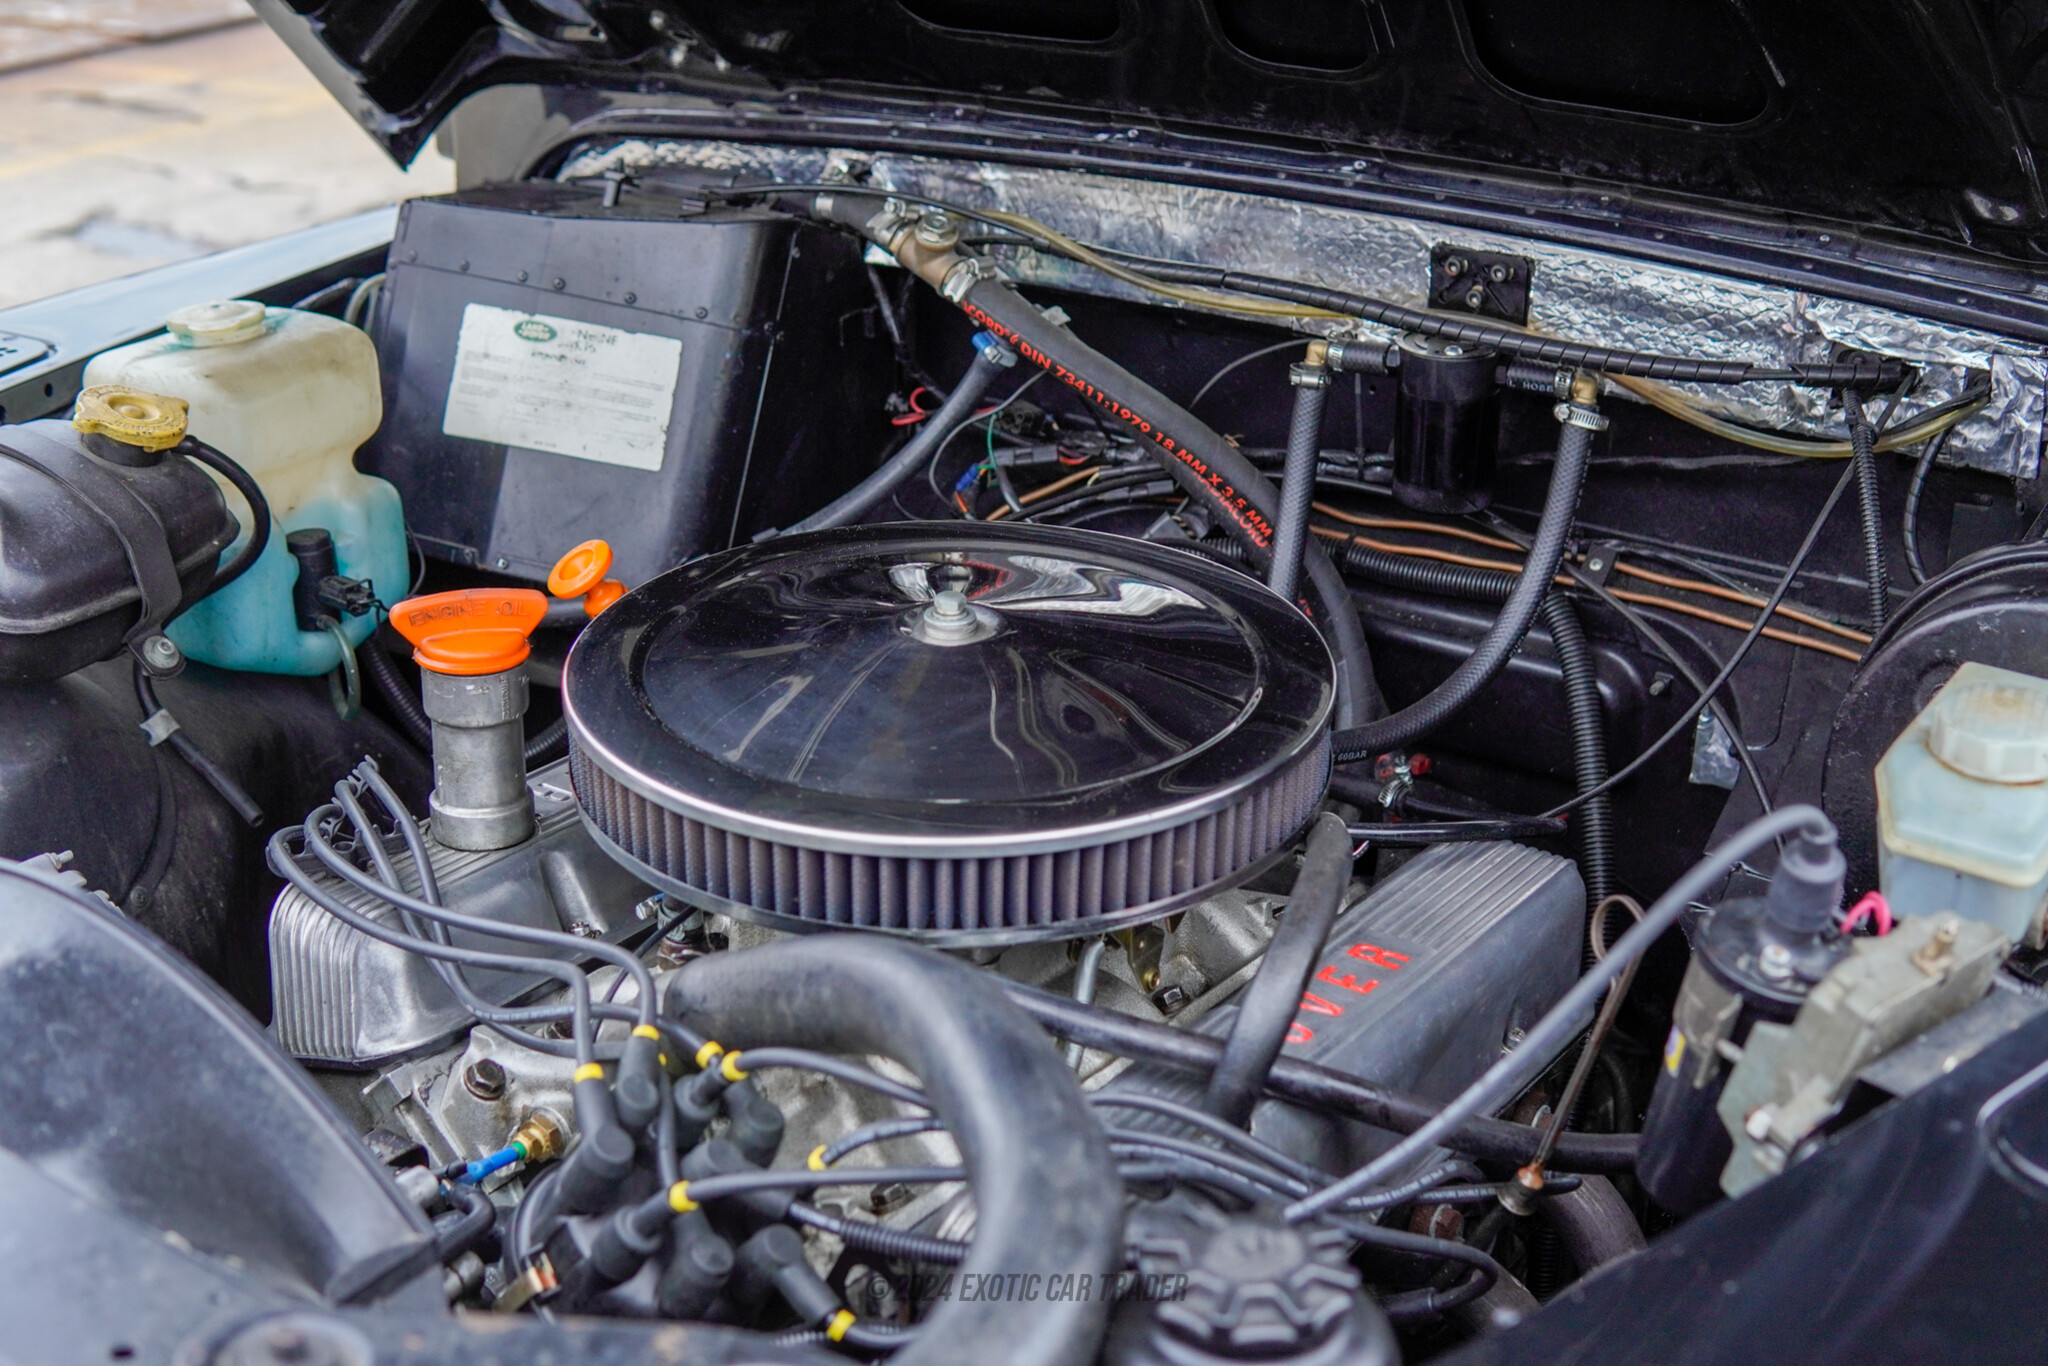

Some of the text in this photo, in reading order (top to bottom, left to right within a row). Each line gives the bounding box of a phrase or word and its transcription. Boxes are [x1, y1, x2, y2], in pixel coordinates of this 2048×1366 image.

[1020, 341, 1052, 369] DIN
[1056, 364, 1151, 433] 73411:1979
[1154, 431, 1176, 451] 18
[1176, 448, 1208, 475] MM
[1221, 485, 1248, 509] 3.5
[1245, 509, 1273, 538] MM
[408, 600, 529, 627] ENGINE OIL
